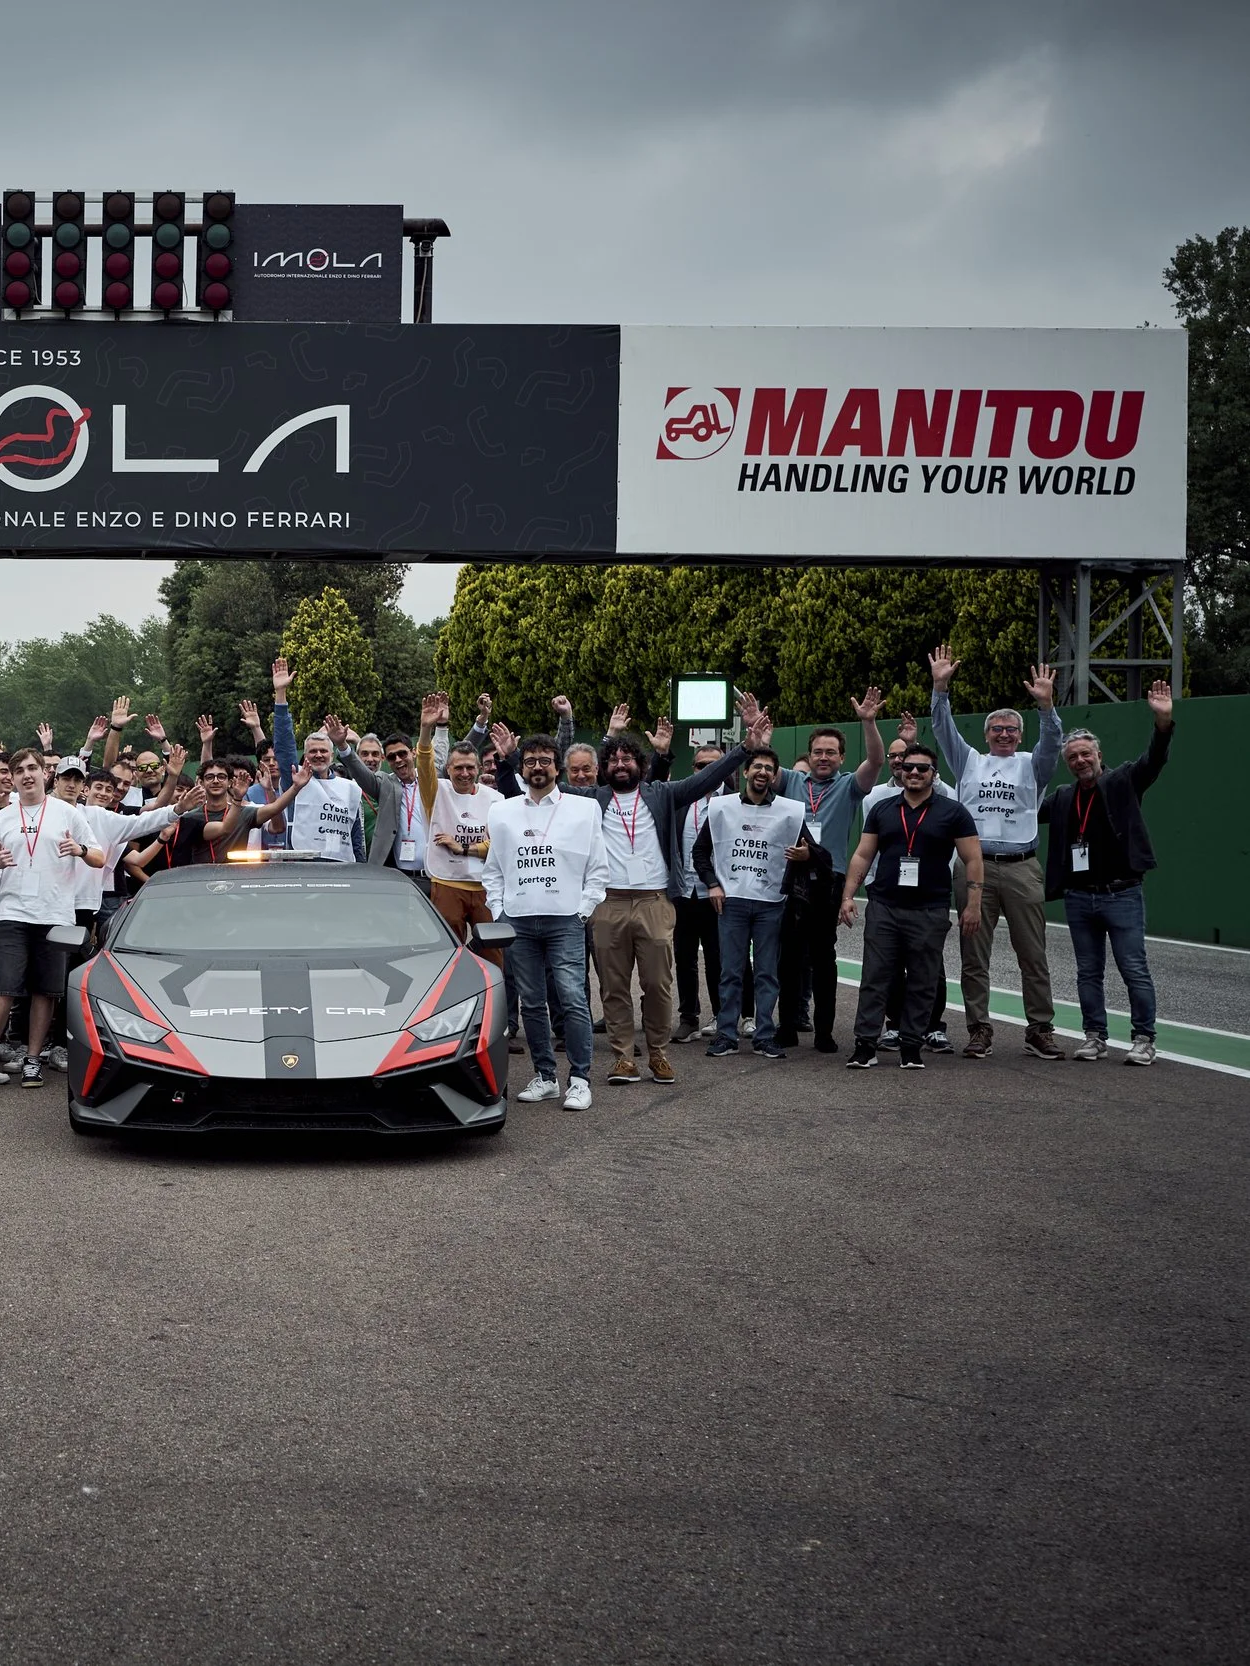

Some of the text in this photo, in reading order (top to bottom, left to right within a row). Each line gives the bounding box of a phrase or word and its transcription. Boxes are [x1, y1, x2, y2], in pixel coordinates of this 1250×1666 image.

[253, 248, 382, 271] IMOLA
[31, 350, 81, 366] 1953
[744, 387, 1146, 461] MANITOU
[737, 463, 1136, 496] HANDLING YOUR WORLD
[76, 511, 142, 528] ENZO
[152, 511, 165, 528] E
[175, 511, 237, 528] DINO
[247, 511, 351, 529] FERRARI
[978, 789, 1015, 801] DRIVER
[984, 806, 1015, 818] certego
[456, 824, 486, 834] CYBER
[734, 838, 768, 850] CYBER
[517, 845, 553, 857] CYBER
[731, 848, 769, 861] DRIVER
[517, 857, 556, 869] DRIVER
[737, 865, 768, 878] certego
[523, 876, 557, 888] certego
[189, 1007, 387, 1018] SAFETY CAR
